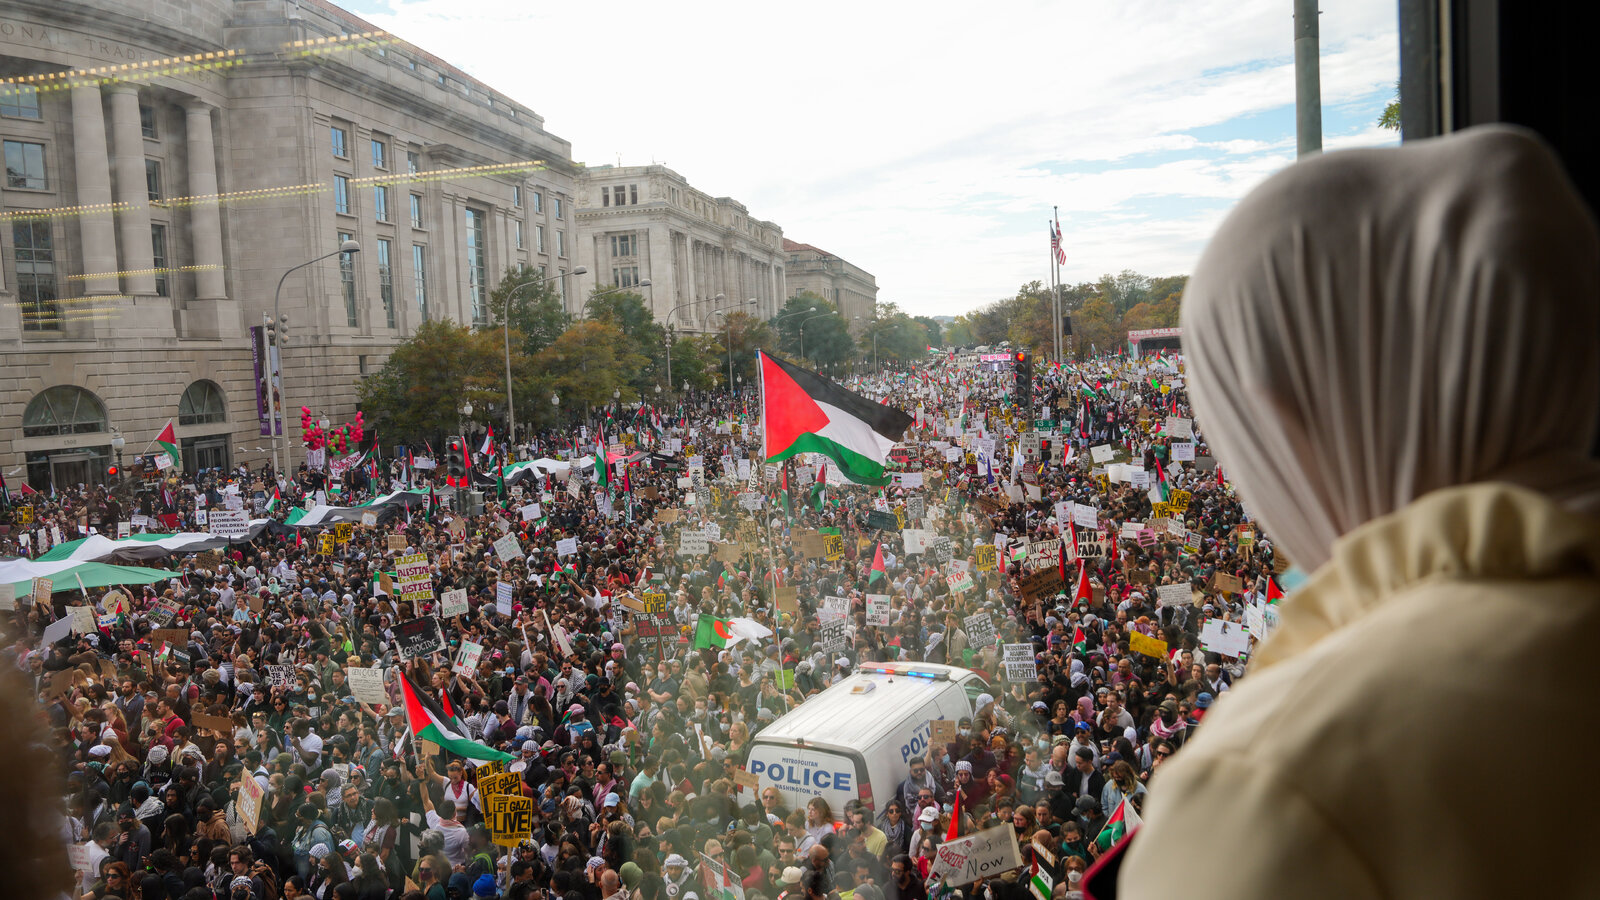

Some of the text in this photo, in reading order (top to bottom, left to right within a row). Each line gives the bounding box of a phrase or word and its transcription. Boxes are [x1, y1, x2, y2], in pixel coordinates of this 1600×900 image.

[1078, 532, 1098, 543] INTI
[934, 540, 951, 552] FREE
[1078, 544, 1102, 556] FADA
[397, 565, 429, 577] PALESTINE
[947, 571, 965, 586] STOP
[401, 581, 432, 595] JUSTICE
[1037, 585, 1056, 597] PAUSE
[449, 592, 462, 600] END
[402, 620, 426, 635] STOP
[822, 623, 845, 641] FREE
[966, 617, 993, 638] FREE
[409, 633, 424, 643] THE
[403, 639, 438, 657] GENOCIDE
[1008, 669, 1036, 678] RIGHT!
[782, 757, 818, 767] METROPOLITAN
[477, 760, 503, 779] END THE
[751, 759, 851, 792] POLICE
[245, 775, 260, 800] STOP
[481, 773, 520, 797] LET GAZA
[493, 799, 531, 812] LET GAZA
[493, 811, 531, 833] LIVE!
